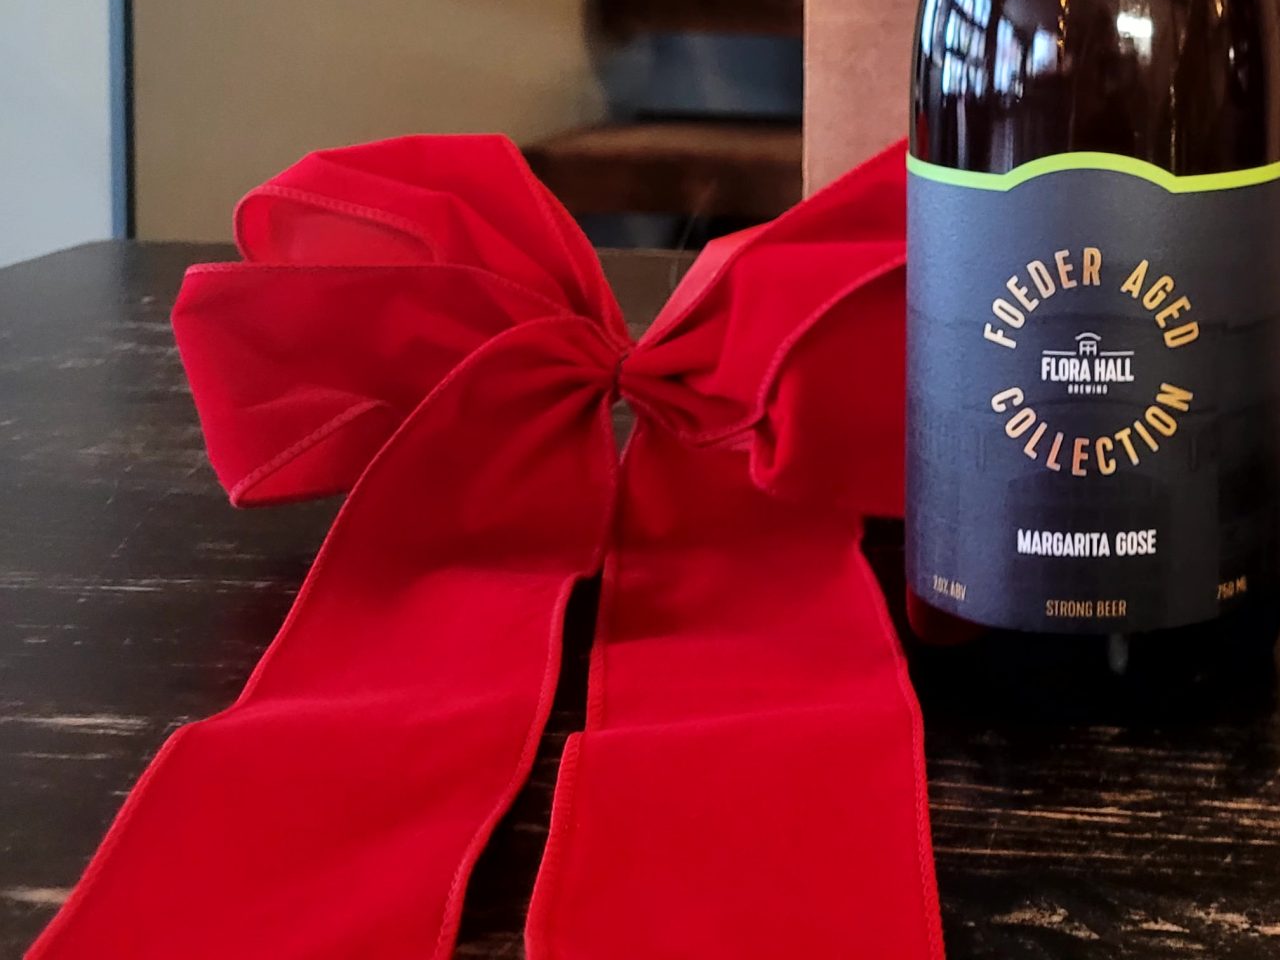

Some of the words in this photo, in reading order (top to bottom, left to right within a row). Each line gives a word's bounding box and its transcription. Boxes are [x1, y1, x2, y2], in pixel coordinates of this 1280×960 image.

[983, 247, 1102, 349] FOEDER
[1120, 259, 1200, 348] AGED
[1041, 357, 1091, 382] FLORA
[1094, 357, 1134, 382] HALL
[991, 382, 1194, 476] COLLECTION
[1017, 528, 1110, 557] MARGARITA
[1115, 529, 1157, 556] GOSE
[1045, 599, 1093, 617] STRONG
[1096, 600, 1127, 617] BEER
